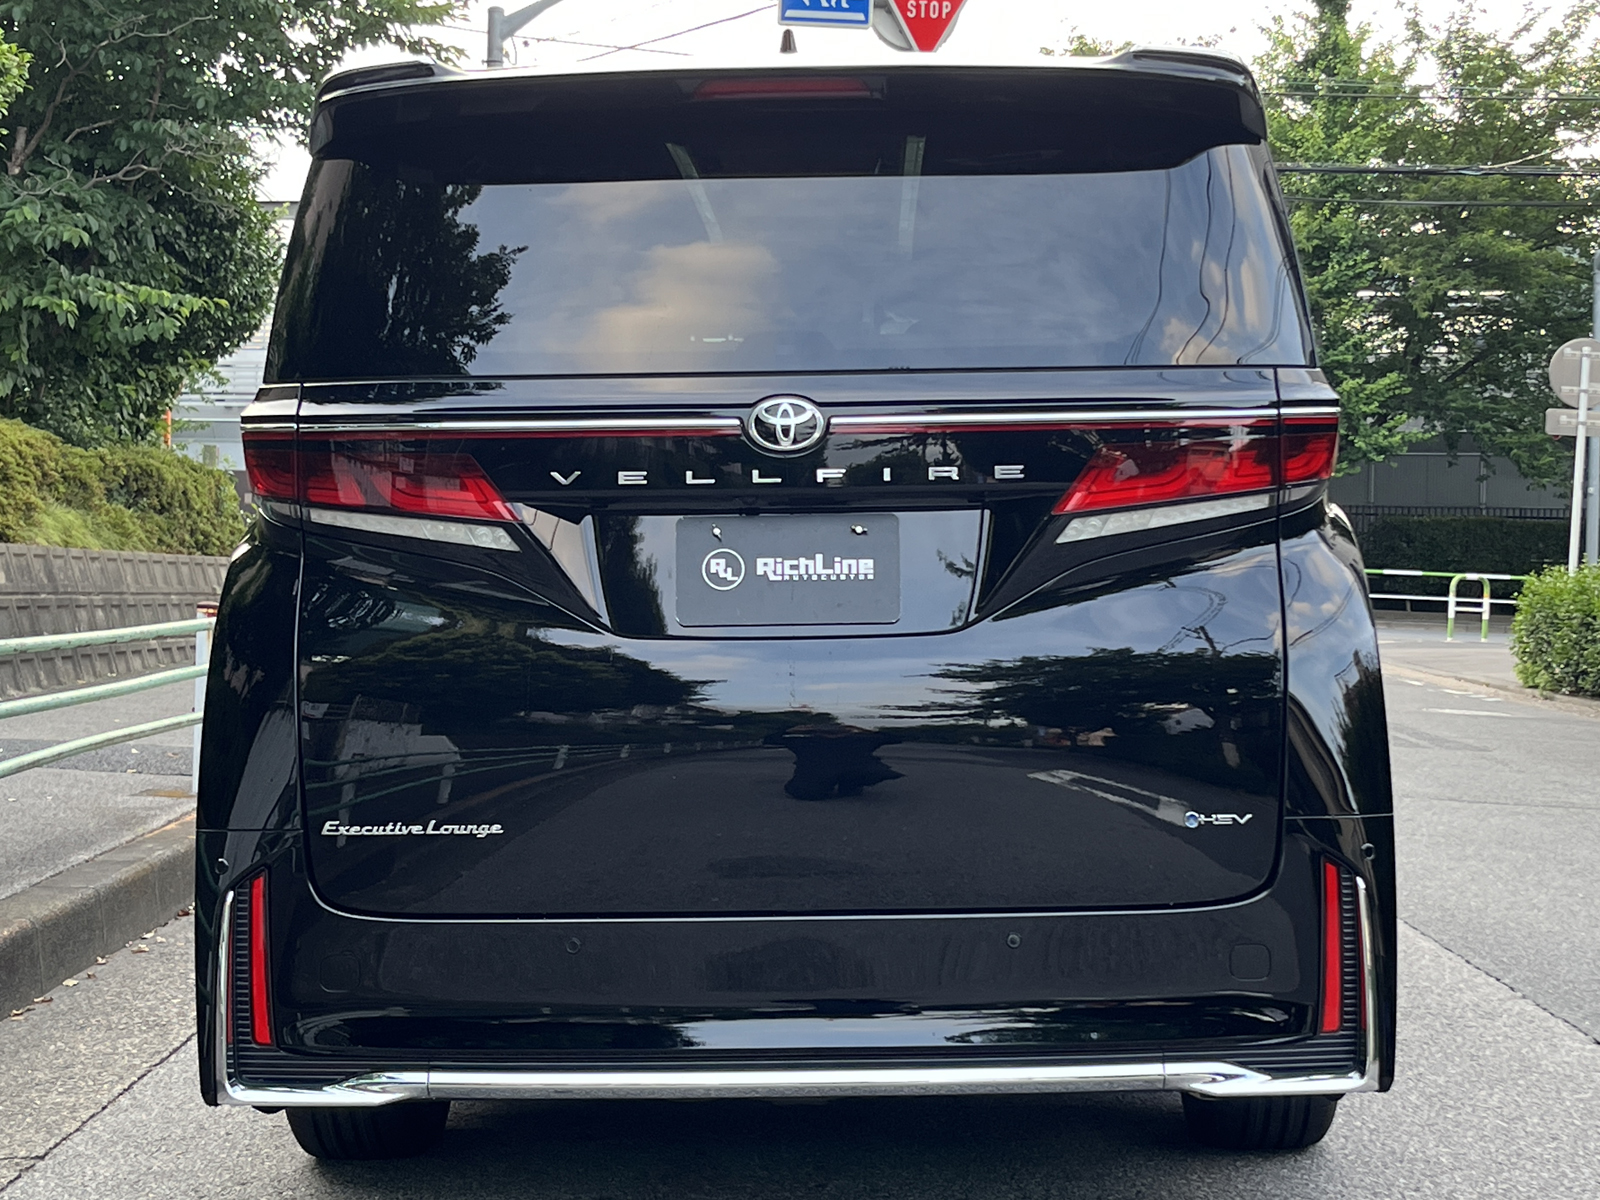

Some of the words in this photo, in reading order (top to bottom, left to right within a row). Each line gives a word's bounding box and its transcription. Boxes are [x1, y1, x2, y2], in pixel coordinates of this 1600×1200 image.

[906, 0, 952, 20] STOP
[549, 464, 1026, 486] VELLFIRE
[321, 820, 425, 836] Executive
[426, 819, 504, 838] Lounge
